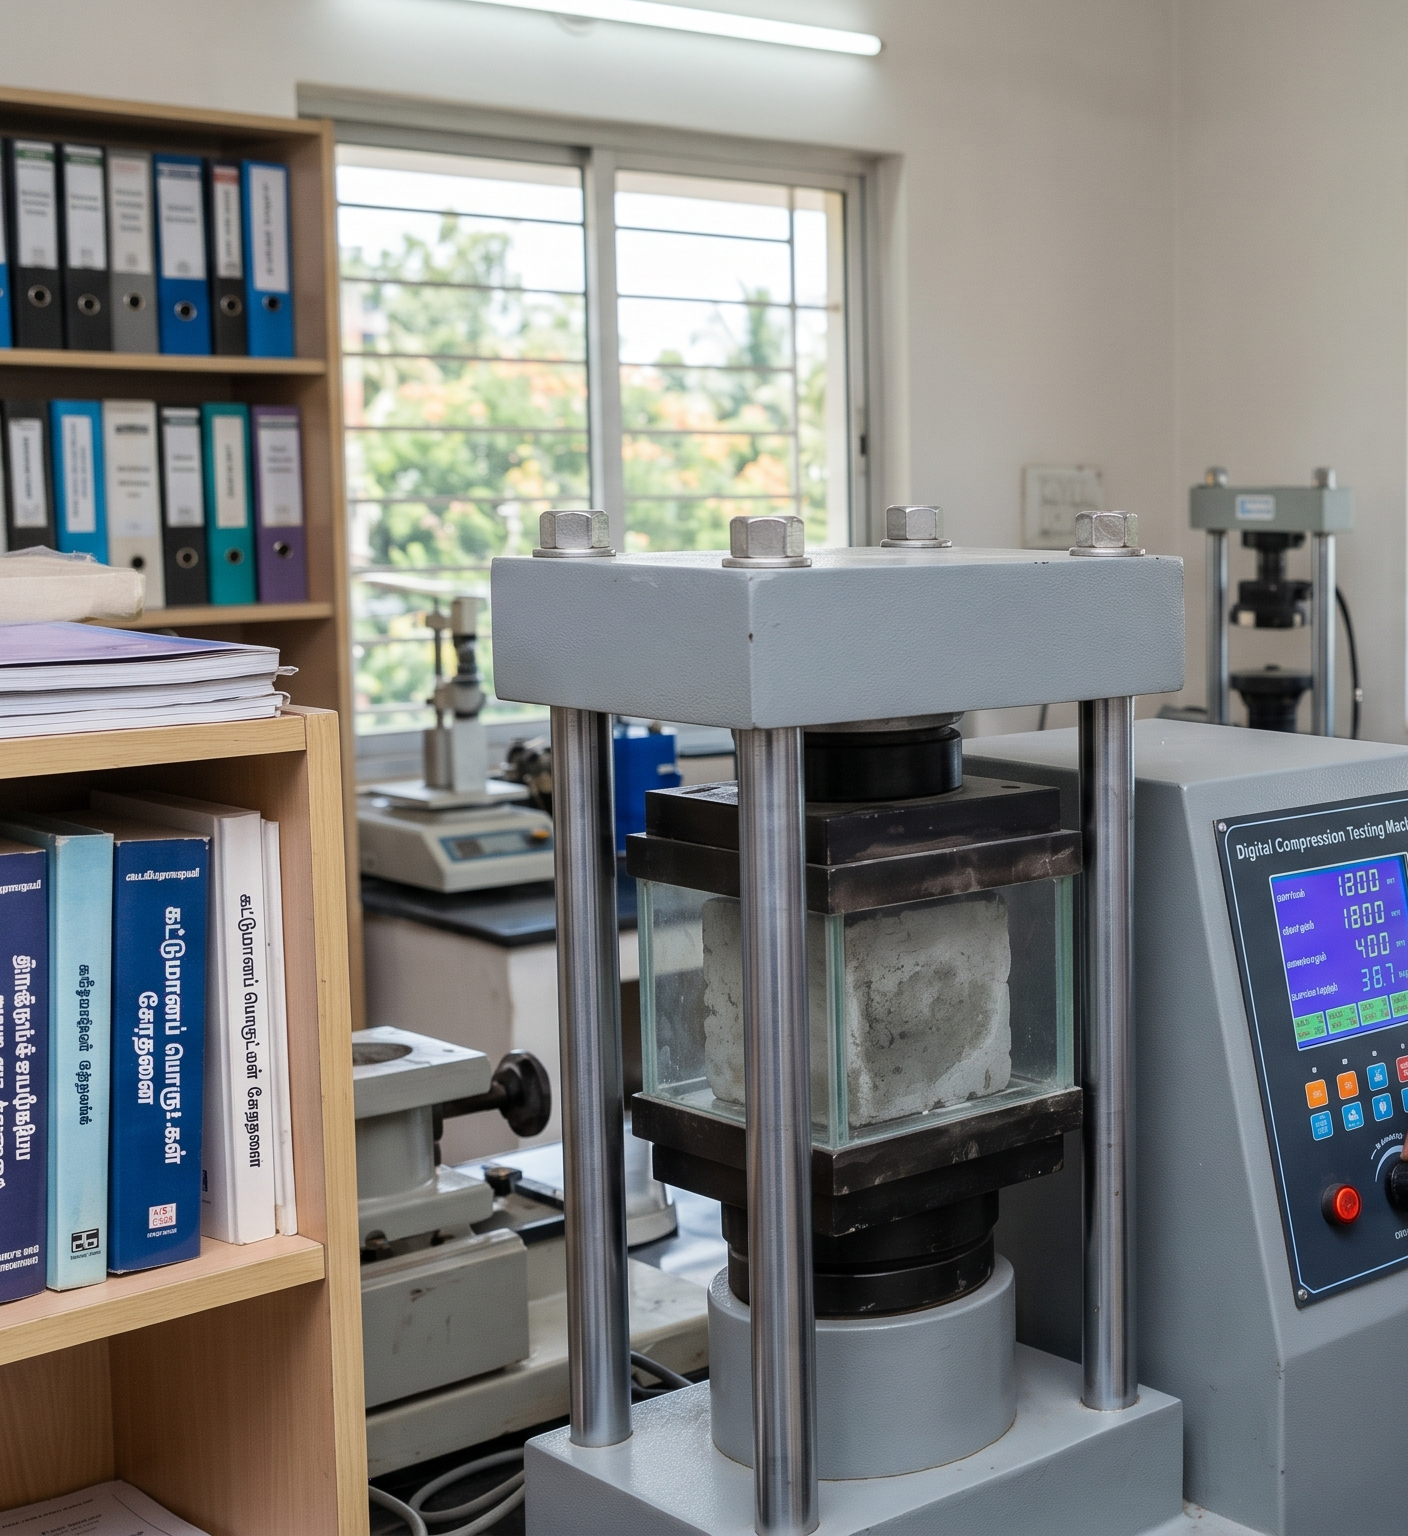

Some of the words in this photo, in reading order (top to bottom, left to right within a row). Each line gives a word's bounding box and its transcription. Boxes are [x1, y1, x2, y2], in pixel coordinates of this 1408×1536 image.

[1236, 839, 1273, 861] Digital
[1275, 829, 1345, 853] Compression
[1347, 822, 1385, 839] Testing
[1343, 900, 1385, 929] 1800
[1355, 931, 1390, 958] 400
[160, 906, 187, 1035] கட்டுமானப்
[1360, 962, 1395, 992] 38.7
